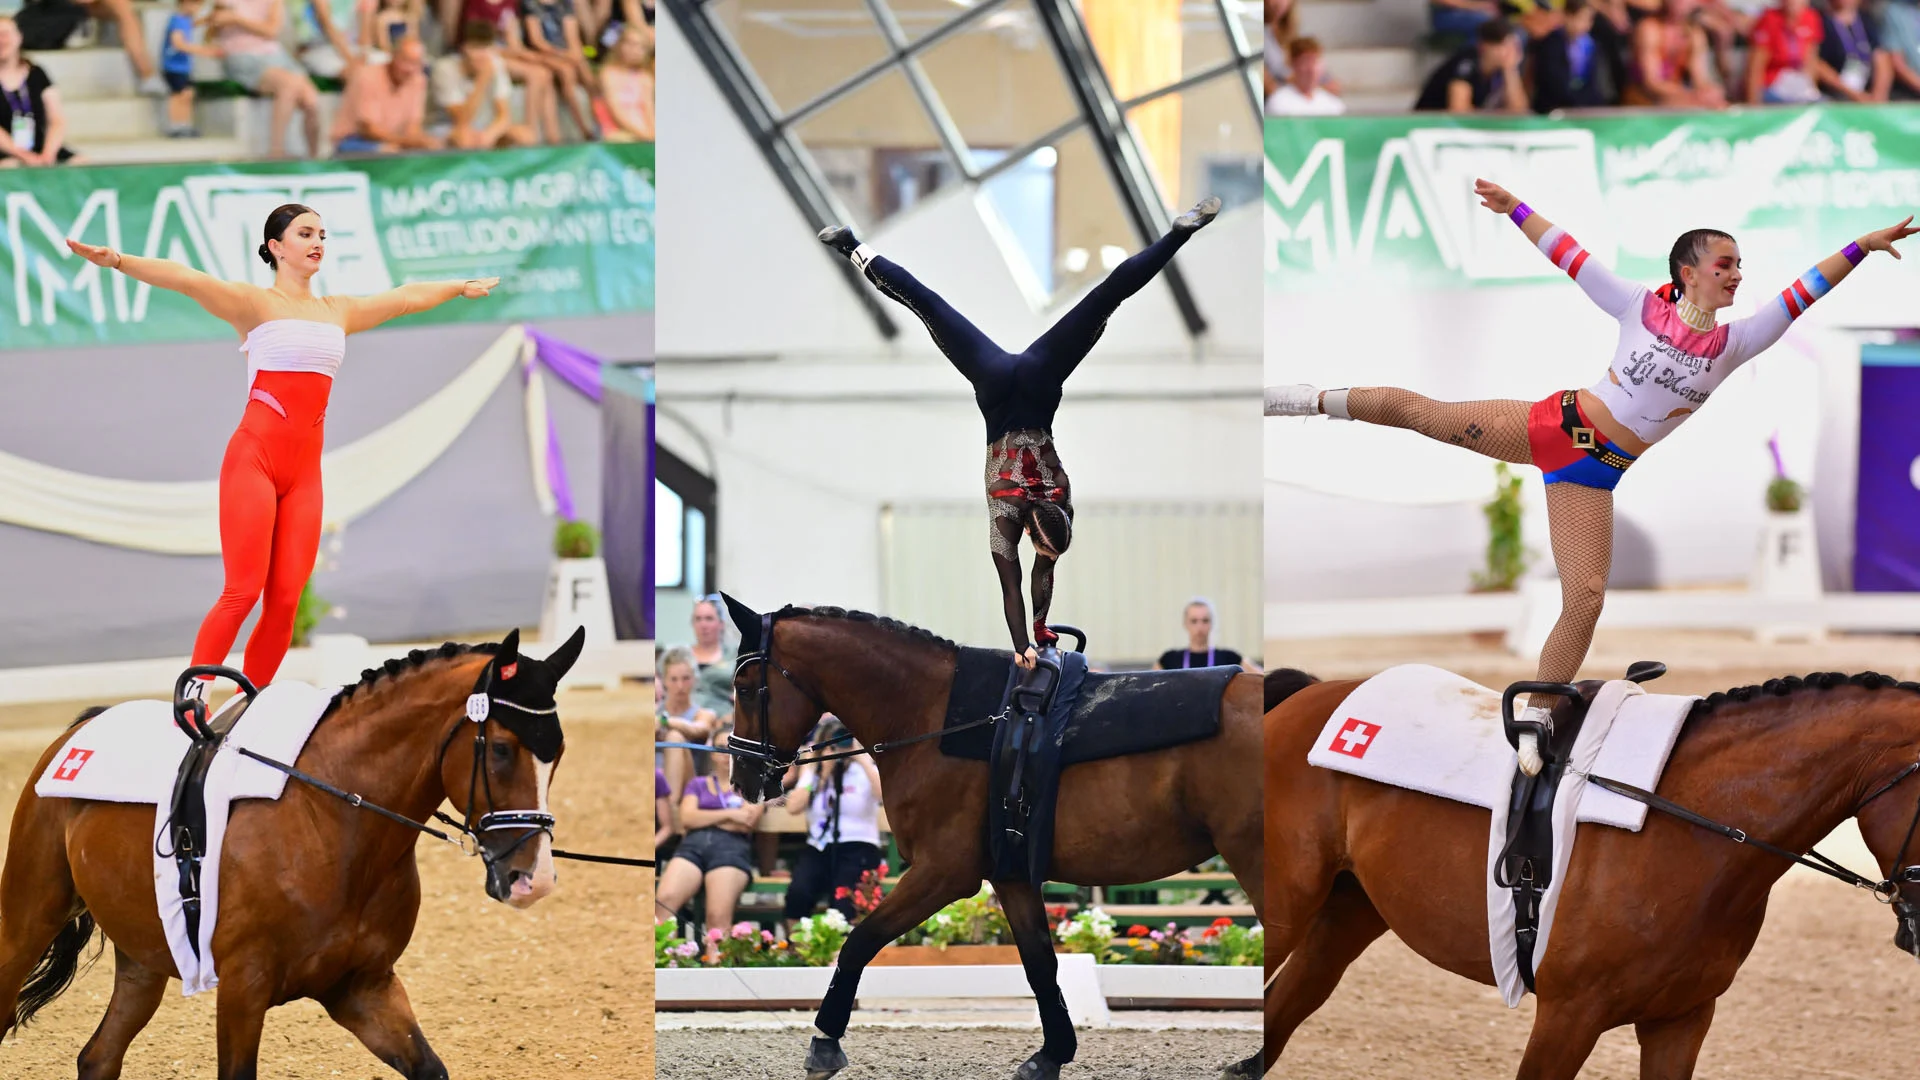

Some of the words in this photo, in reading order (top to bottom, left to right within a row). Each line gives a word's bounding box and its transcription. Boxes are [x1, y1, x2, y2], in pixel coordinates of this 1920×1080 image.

[1650, 334, 1713, 376] Daddy's
[571, 577, 594, 613] F
[185, 680, 204, 700] 71
